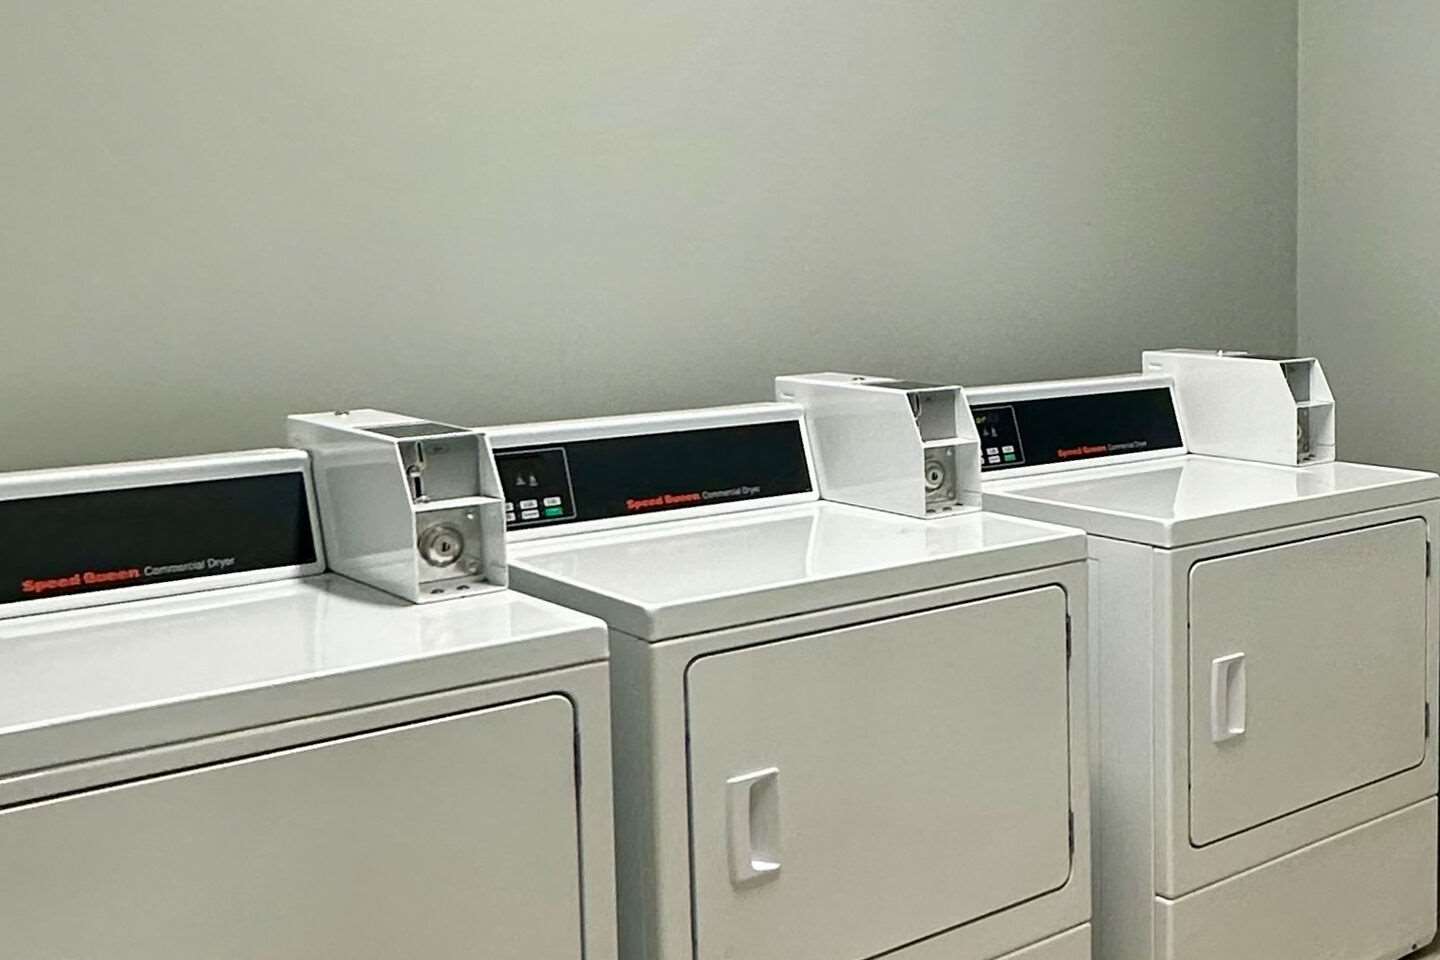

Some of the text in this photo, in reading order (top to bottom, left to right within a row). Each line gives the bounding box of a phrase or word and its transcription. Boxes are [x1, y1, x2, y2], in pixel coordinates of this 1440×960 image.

[22, 557, 236, 593] Speed Queen Commercial Dryer
